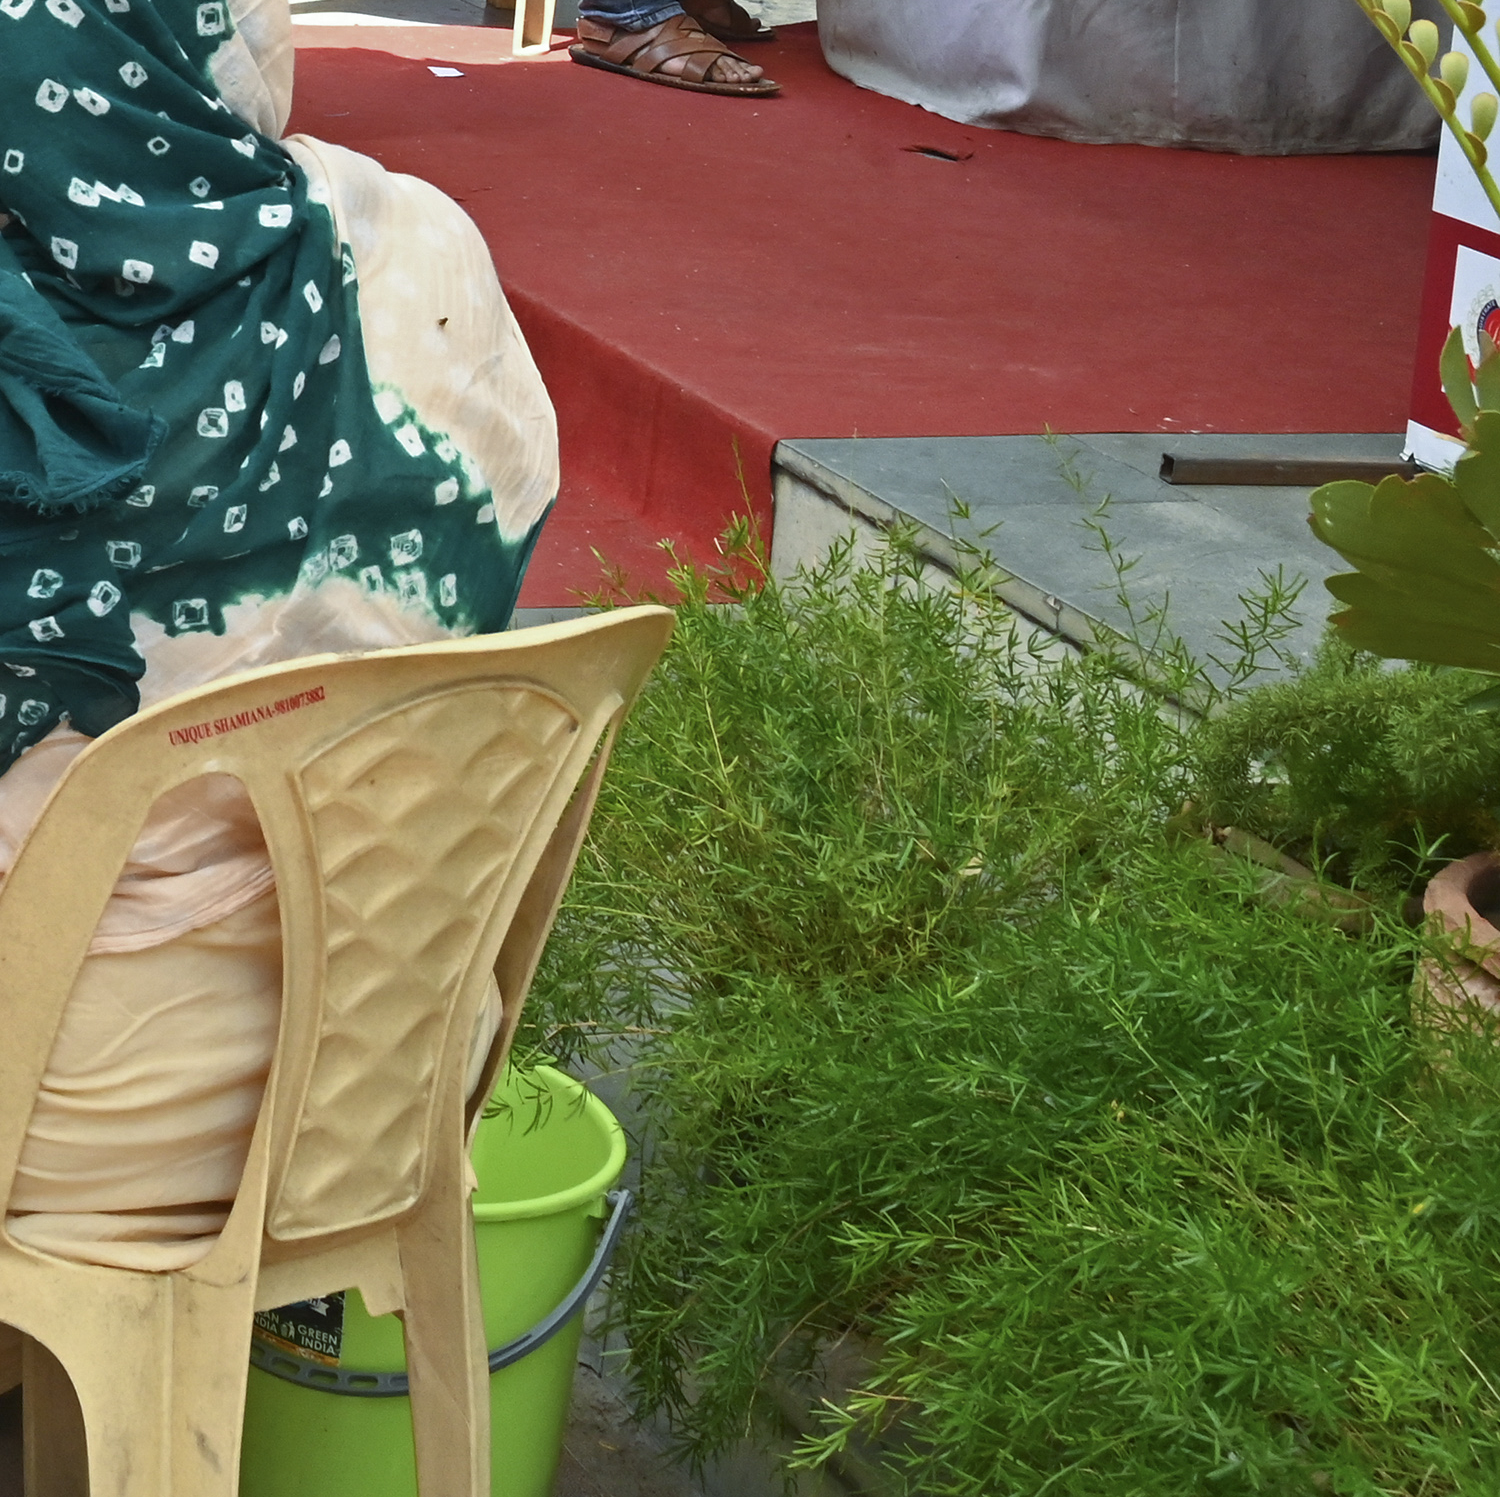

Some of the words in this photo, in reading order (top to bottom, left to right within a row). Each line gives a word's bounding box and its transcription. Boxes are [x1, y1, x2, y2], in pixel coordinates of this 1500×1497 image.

[168, 722, 213, 746] UNIQUE
[254, 1315, 278, 1334] NDIA
[297, 1324, 337, 1346] GREEN
[301, 1335, 336, 1356] INDIA
